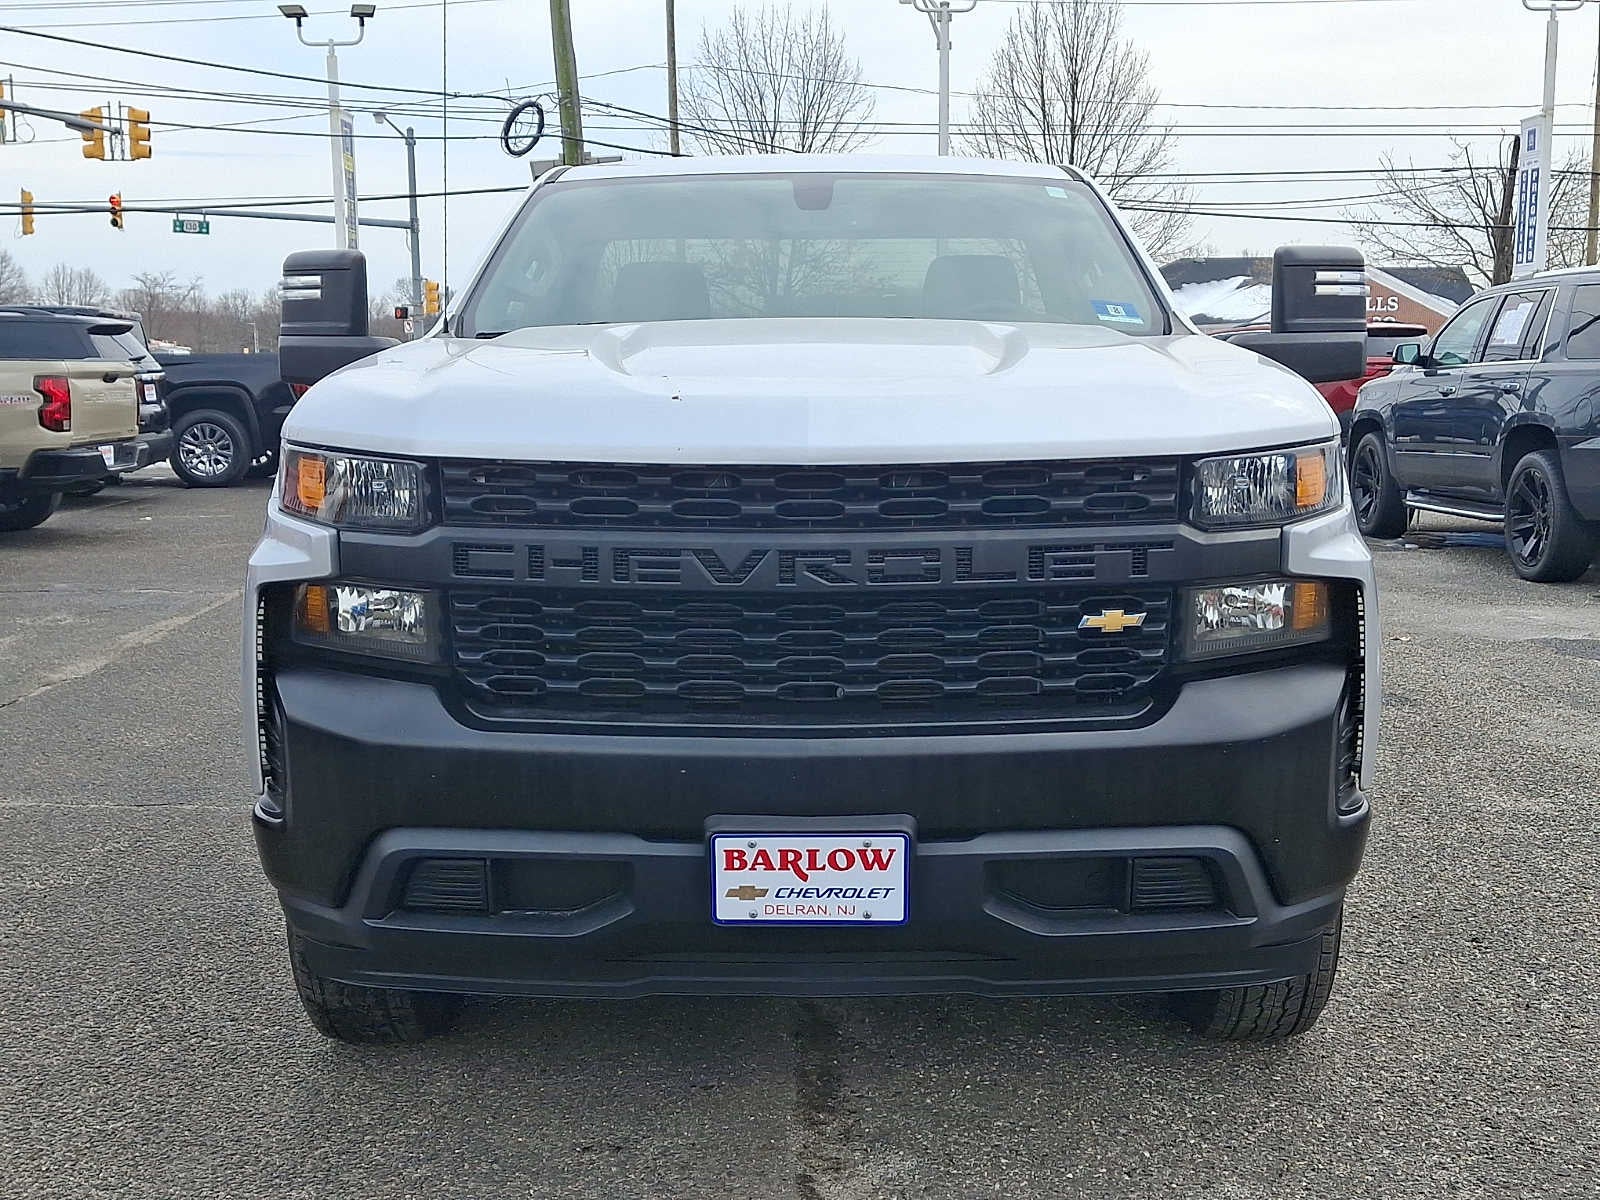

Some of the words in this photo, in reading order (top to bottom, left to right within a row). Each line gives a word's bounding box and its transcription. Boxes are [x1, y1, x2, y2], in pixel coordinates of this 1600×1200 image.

[452, 540, 1175, 586] CHEVROLET
[723, 848, 897, 883] BARLOW
[774, 887, 896, 899] CHEVROLET
[764, 904, 832, 916] DELRAN,
[837, 904, 856, 916] NJ
